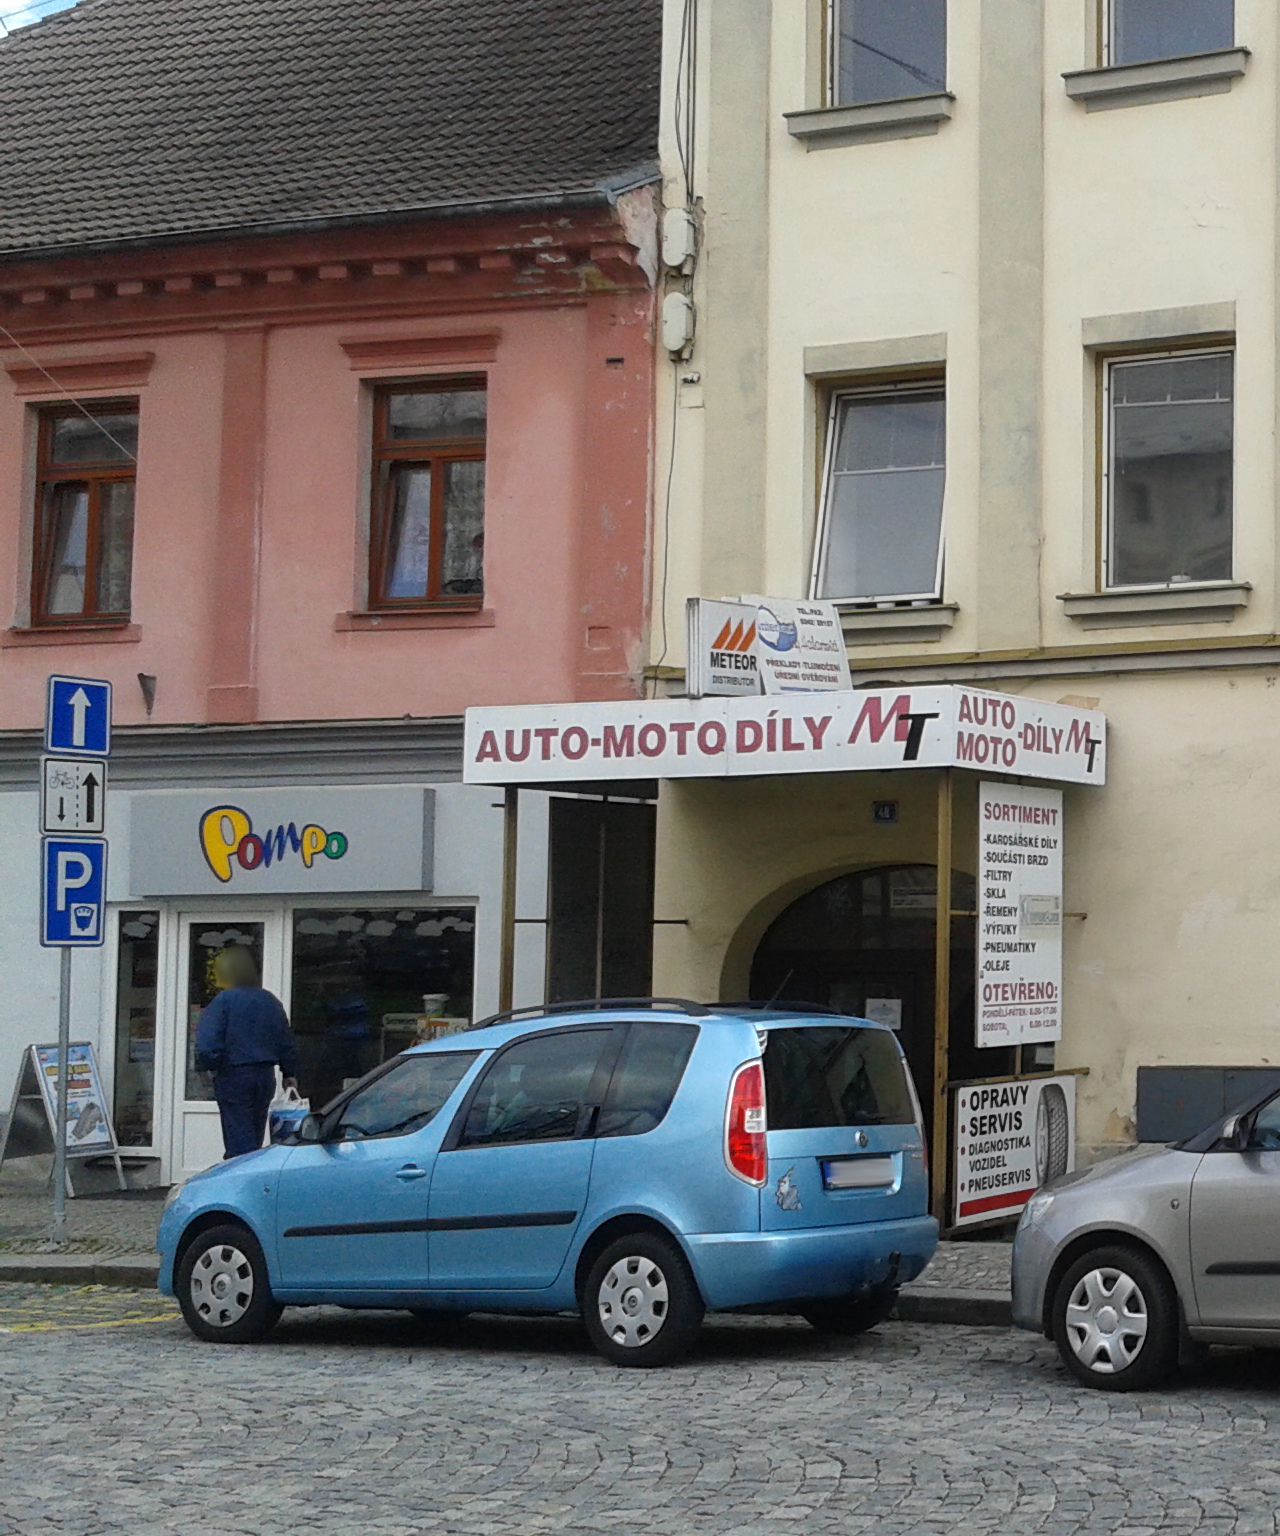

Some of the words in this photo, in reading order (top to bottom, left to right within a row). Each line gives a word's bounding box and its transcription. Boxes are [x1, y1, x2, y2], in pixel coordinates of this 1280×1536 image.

[710, 651, 758, 671] METEOR
[712, 674, 755, 687] DISTRIBUTOR
[958, 694, 1016, 730] AUTO
[475, 720, 727, 763] AUTO-MOTO
[736, 710, 832, 754] DÍLY
[956, 730, 1016, 767] MOTO
[984, 801, 1058, 826] SORTIMENT
[1041, 836, 1058, 849] DÍLY
[1027, 854, 1049, 866] BRZD
[56, 851, 93, 912] P
[983, 977, 1058, 1003] OTEVŘENO:
[969, 1085, 1029, 1111] OPRAVY
[969, 1110, 1023, 1137] SERVIS
[968, 1135, 1032, 1156] DIAGNOSTIKA
[969, 1155, 1008, 1173] VOZIDEL
[968, 1168, 1032, 1193] PNEUSERVIS
